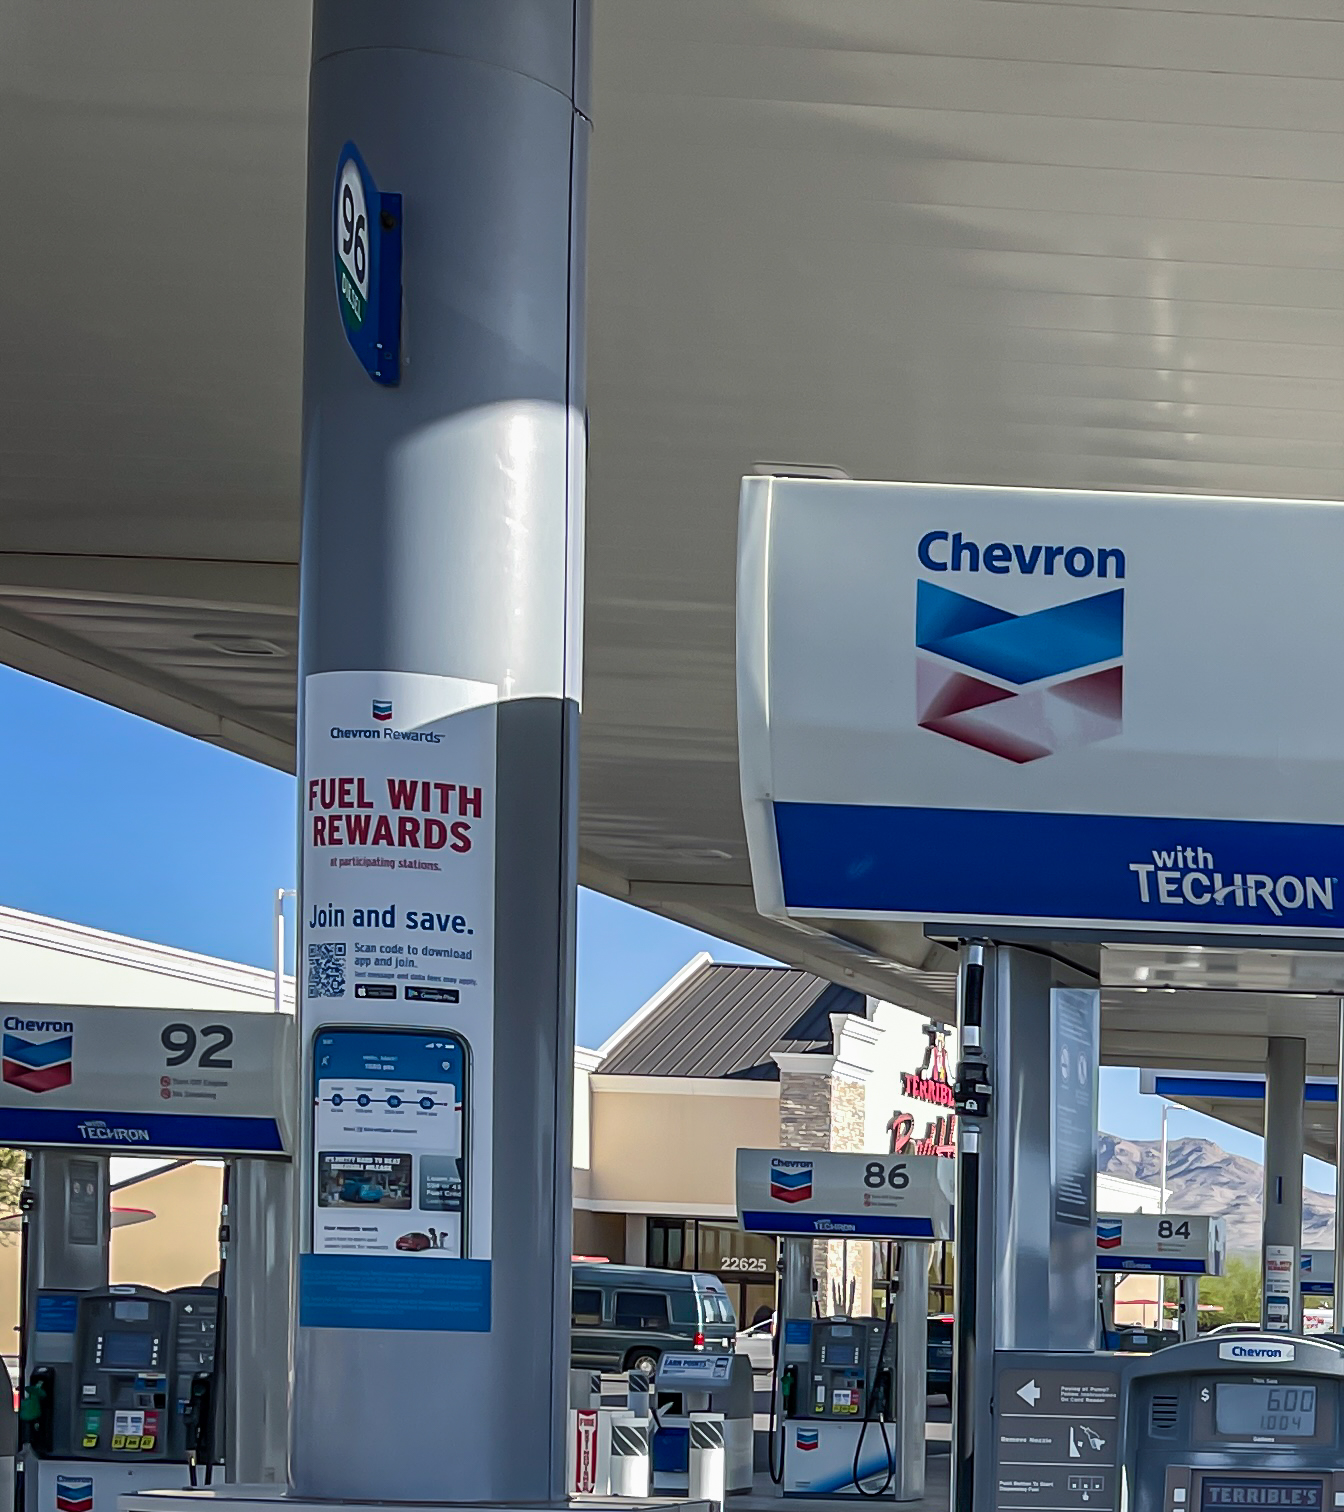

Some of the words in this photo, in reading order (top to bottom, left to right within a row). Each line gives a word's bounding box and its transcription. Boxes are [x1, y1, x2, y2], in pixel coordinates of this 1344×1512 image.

[343, 184, 366, 285] 96
[917, 530, 1125, 580] Chevron
[330, 727, 380, 739] Chevron
[383, 728, 441, 743] Rewards
[309, 777, 374, 811] FUEL
[387, 778, 483, 818] WITH
[313, 814, 472, 853] REWARDS
[339, 857, 395, 869] participating
[1153, 844, 1214, 870] with
[1129, 862, 1334, 916] TECHRON
[309, 902, 345, 928] Join
[352, 904, 396, 928] and
[405, 911, 474, 935] save.
[354, 942, 376, 953] Scan
[379, 944, 404, 954] code
[407, 945, 418, 956] to
[421, 945, 472, 960] download
[354, 959, 371, 967] app
[374, 957, 392, 967] and
[395, 957, 418, 969] join.
[4, 1016, 74, 1032] Chevron
[160, 1023, 234, 1070] 92
[77, 1124, 150, 1142] TECHRON
[770, 1157, 814, 1169] Chevron
[863, 1161, 910, 1189] 86
[1158, 1220, 1191, 1239] 84
[721, 1256, 767, 1272] 22625
[1231, 1346, 1282, 1358] Chevron
[1200, 1388, 1210, 1402] $
[1209, 1487, 1317, 1504] TERRIBLE'S
